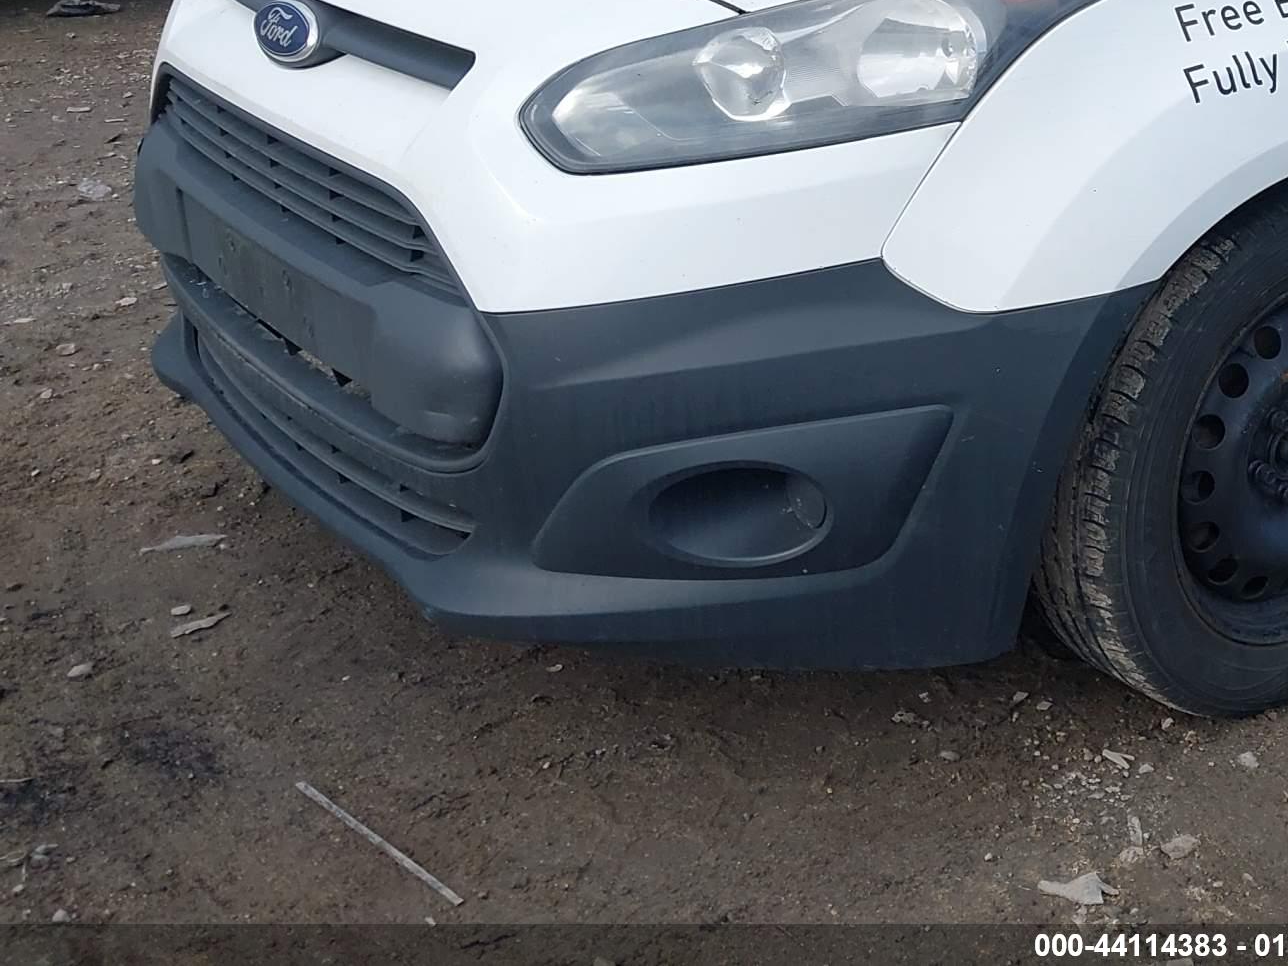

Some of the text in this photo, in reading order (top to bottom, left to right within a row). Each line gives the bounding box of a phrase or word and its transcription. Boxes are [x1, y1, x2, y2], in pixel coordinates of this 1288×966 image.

[259, 6, 299, 48] Ford
[1175, 0, 1265, 42] Free
[1183, 51, 1278, 104] Fully
